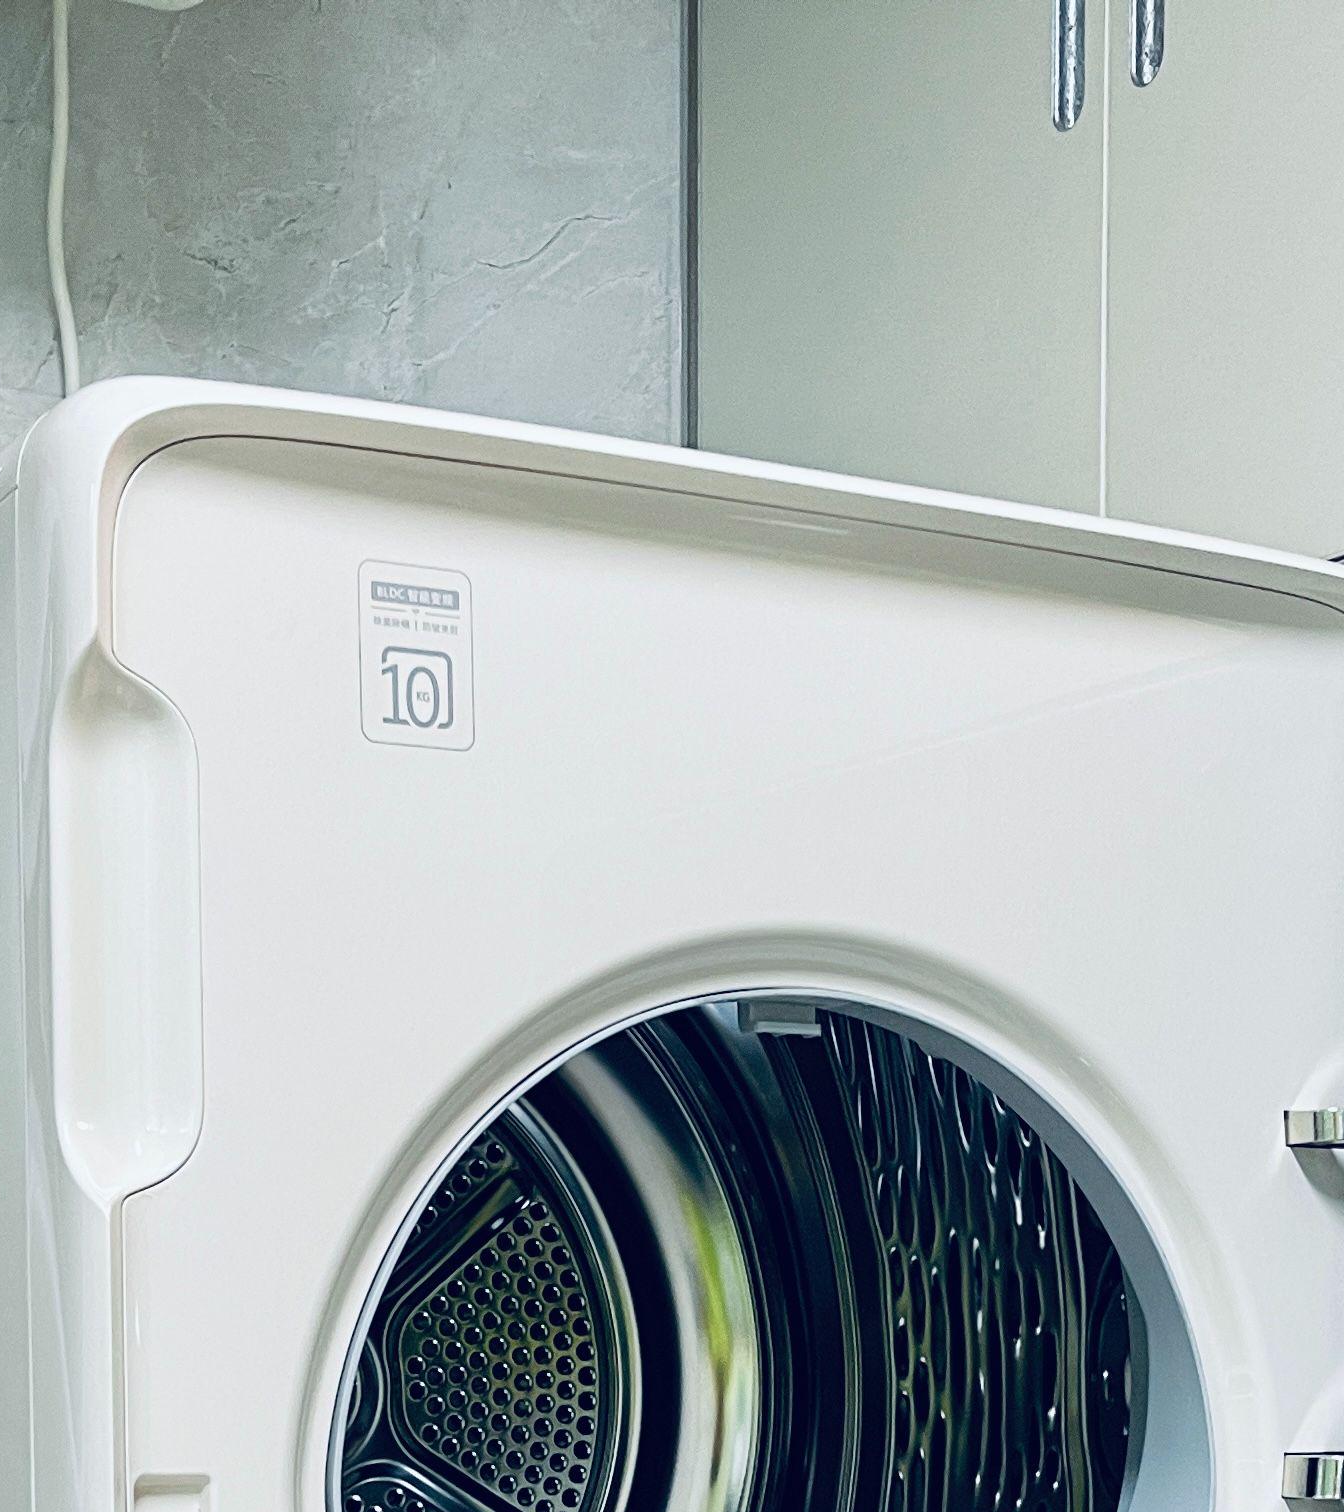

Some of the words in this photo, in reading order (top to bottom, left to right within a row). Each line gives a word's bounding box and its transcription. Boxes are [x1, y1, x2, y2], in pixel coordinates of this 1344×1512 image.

[376, 586, 405, 600] BLDC
[381, 664, 440, 728] 10
[416, 691, 430, 702] KG
